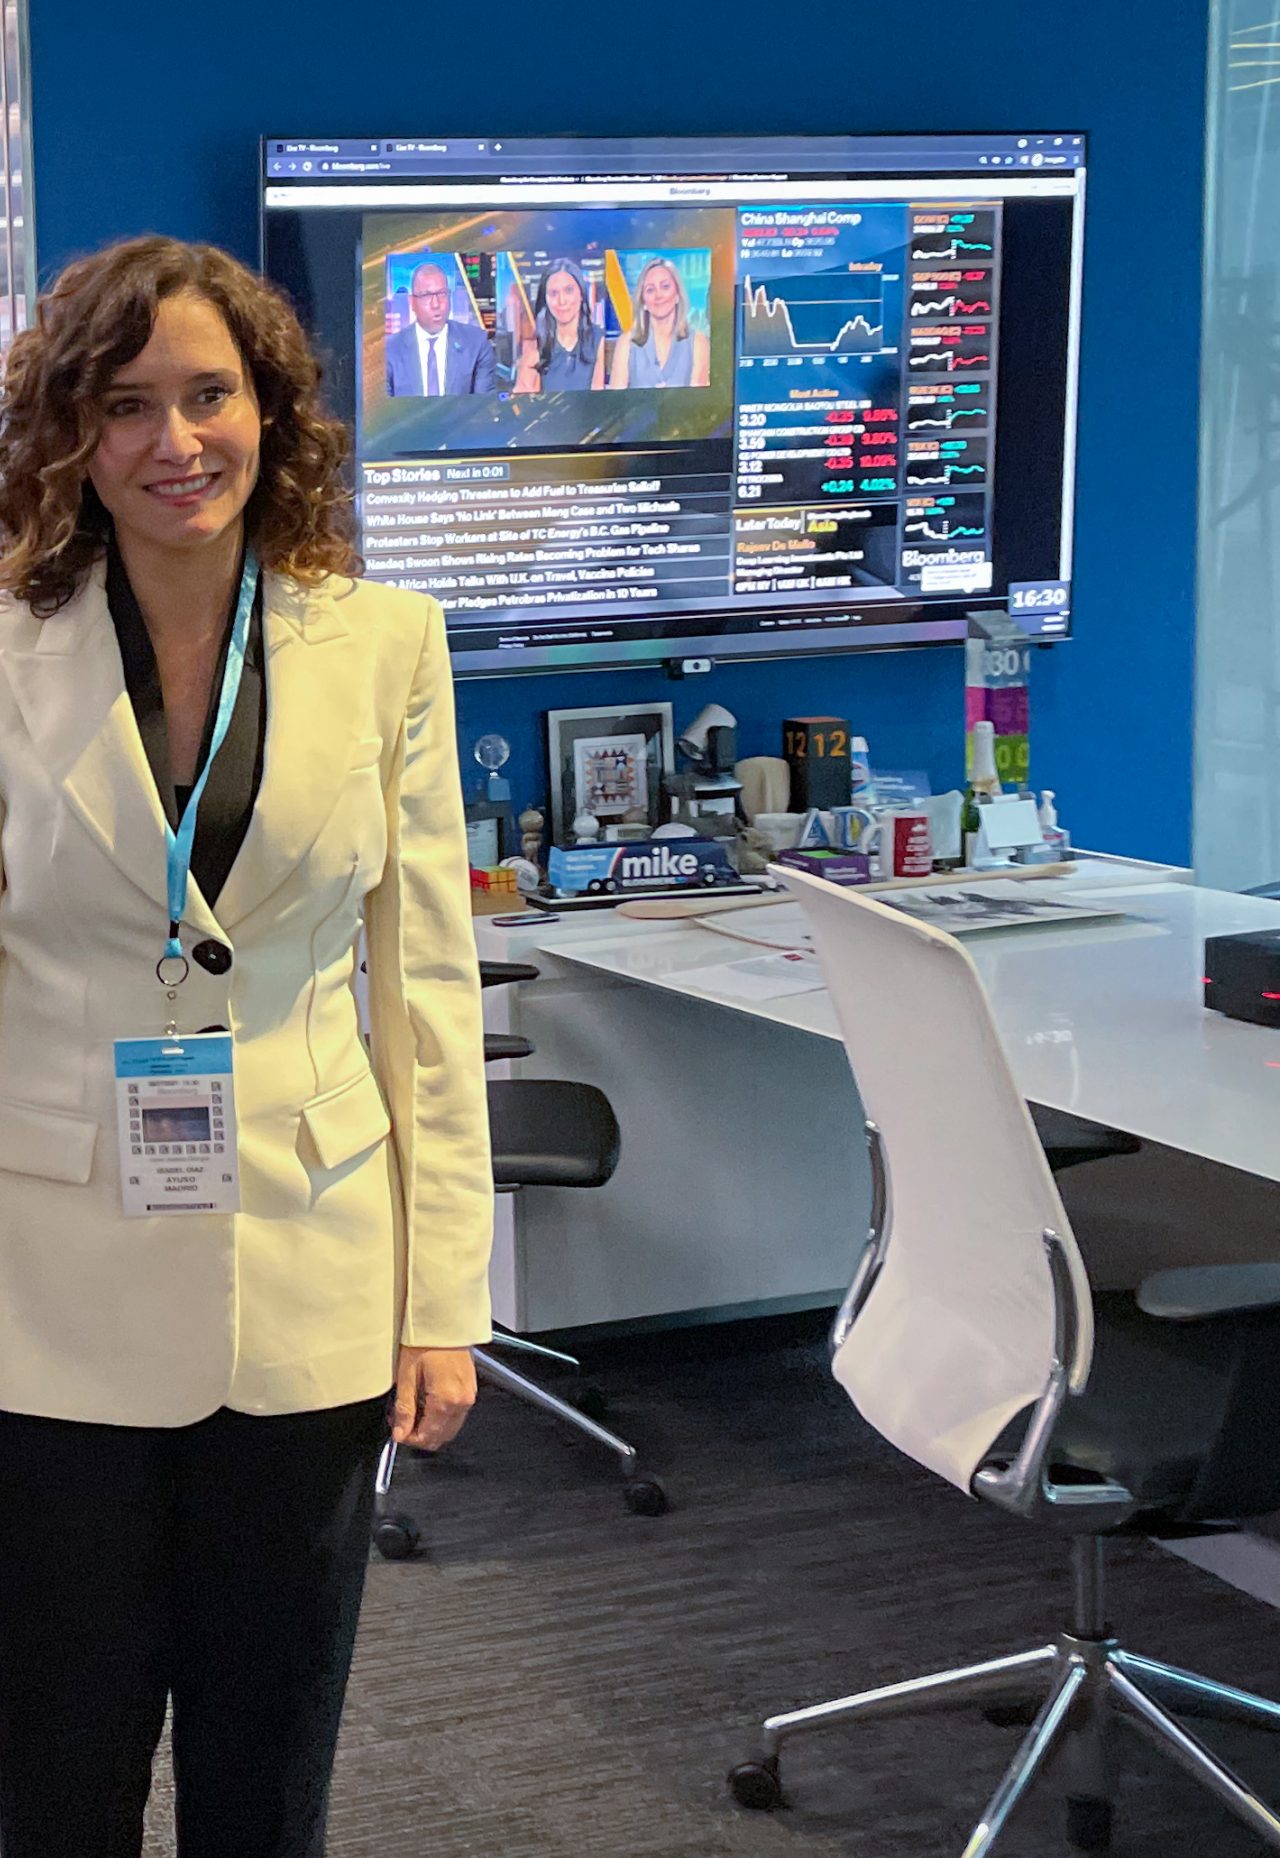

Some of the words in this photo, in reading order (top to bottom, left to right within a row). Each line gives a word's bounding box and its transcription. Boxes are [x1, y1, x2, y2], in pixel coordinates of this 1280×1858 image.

[741, 212, 775, 226] China
[775, 211, 827, 227] Shanghai
[827, 211, 863, 226] Comp
[364, 469, 391, 486] Top
[391, 467, 442, 483] Stories
[446, 467, 471, 479] Next
[471, 466, 482, 478] in
[738, 460, 764, 474] 3.12
[366, 492, 417, 505] Convexity
[417, 490, 459, 503] Hedging
[459, 488, 509, 501] Threatens
[509, 487, 522, 499] to
[522, 485, 543, 498] Add
[543, 485, 565, 497] Fuel
[566, 484, 577, 496] to
[577, 481, 628, 495] Treasuries
[366, 514, 397, 527] White
[397, 513, 429, 526] House
[430, 512, 455, 525] Says
[497, 508, 541, 521] Between
[542, 506, 570, 520] Meng
[570, 505, 596, 517] Case
[596, 503, 615, 516] and
[615, 502, 638, 515] Two
[638, 501, 681, 514] Michaels
[735, 518, 768, 532] Later
[767, 517, 802, 531] Today
[366, 536, 419, 549] Protesters
[419, 534, 444, 547] Stop
[444, 532, 487, 545] Workers
[487, 531, 498, 542] at
[498, 530, 519, 542] Site
[519, 529, 531, 541] of
[531, 528, 547, 540] TC
[610, 524, 631, 536] Gas
[631, 523, 670, 537] Pipeline
[807, 519, 839, 533] Asia
[366, 558, 406, 571] Nasdaq
[405, 556, 441, 568] Swoon
[440, 555, 475, 567] Shows
[475, 553, 506, 566] Rising
[506, 550, 536, 563] Rates
[535, 548, 585, 562] Becoming
[585, 546, 626, 559] Problem
[625, 545, 642, 557] for
[641, 543, 666, 556] Tech
[666, 542, 701, 554] Shares
[902, 548, 986, 568] Bloomberg
[398, 578, 428, 590] Africa
[428, 576, 458, 589] Holds
[458, 575, 485, 587] Talks
[485, 573, 509, 586] With
[530, 573, 544, 583] on
[578, 568, 616, 581] Vaccine
[616, 566, 655, 579] Policies
[458, 596, 498, 609] Pledges
[498, 593, 546, 606] Petrobras
[546, 590, 606, 603] Privatization
[606, 588, 617, 600] in
[617, 587, 629, 599] 10
[629, 587, 658, 599] Years
[1012, 588, 1068, 609] 16:30
[812, 729, 847, 758] 12
[621, 846, 699, 878] mike
